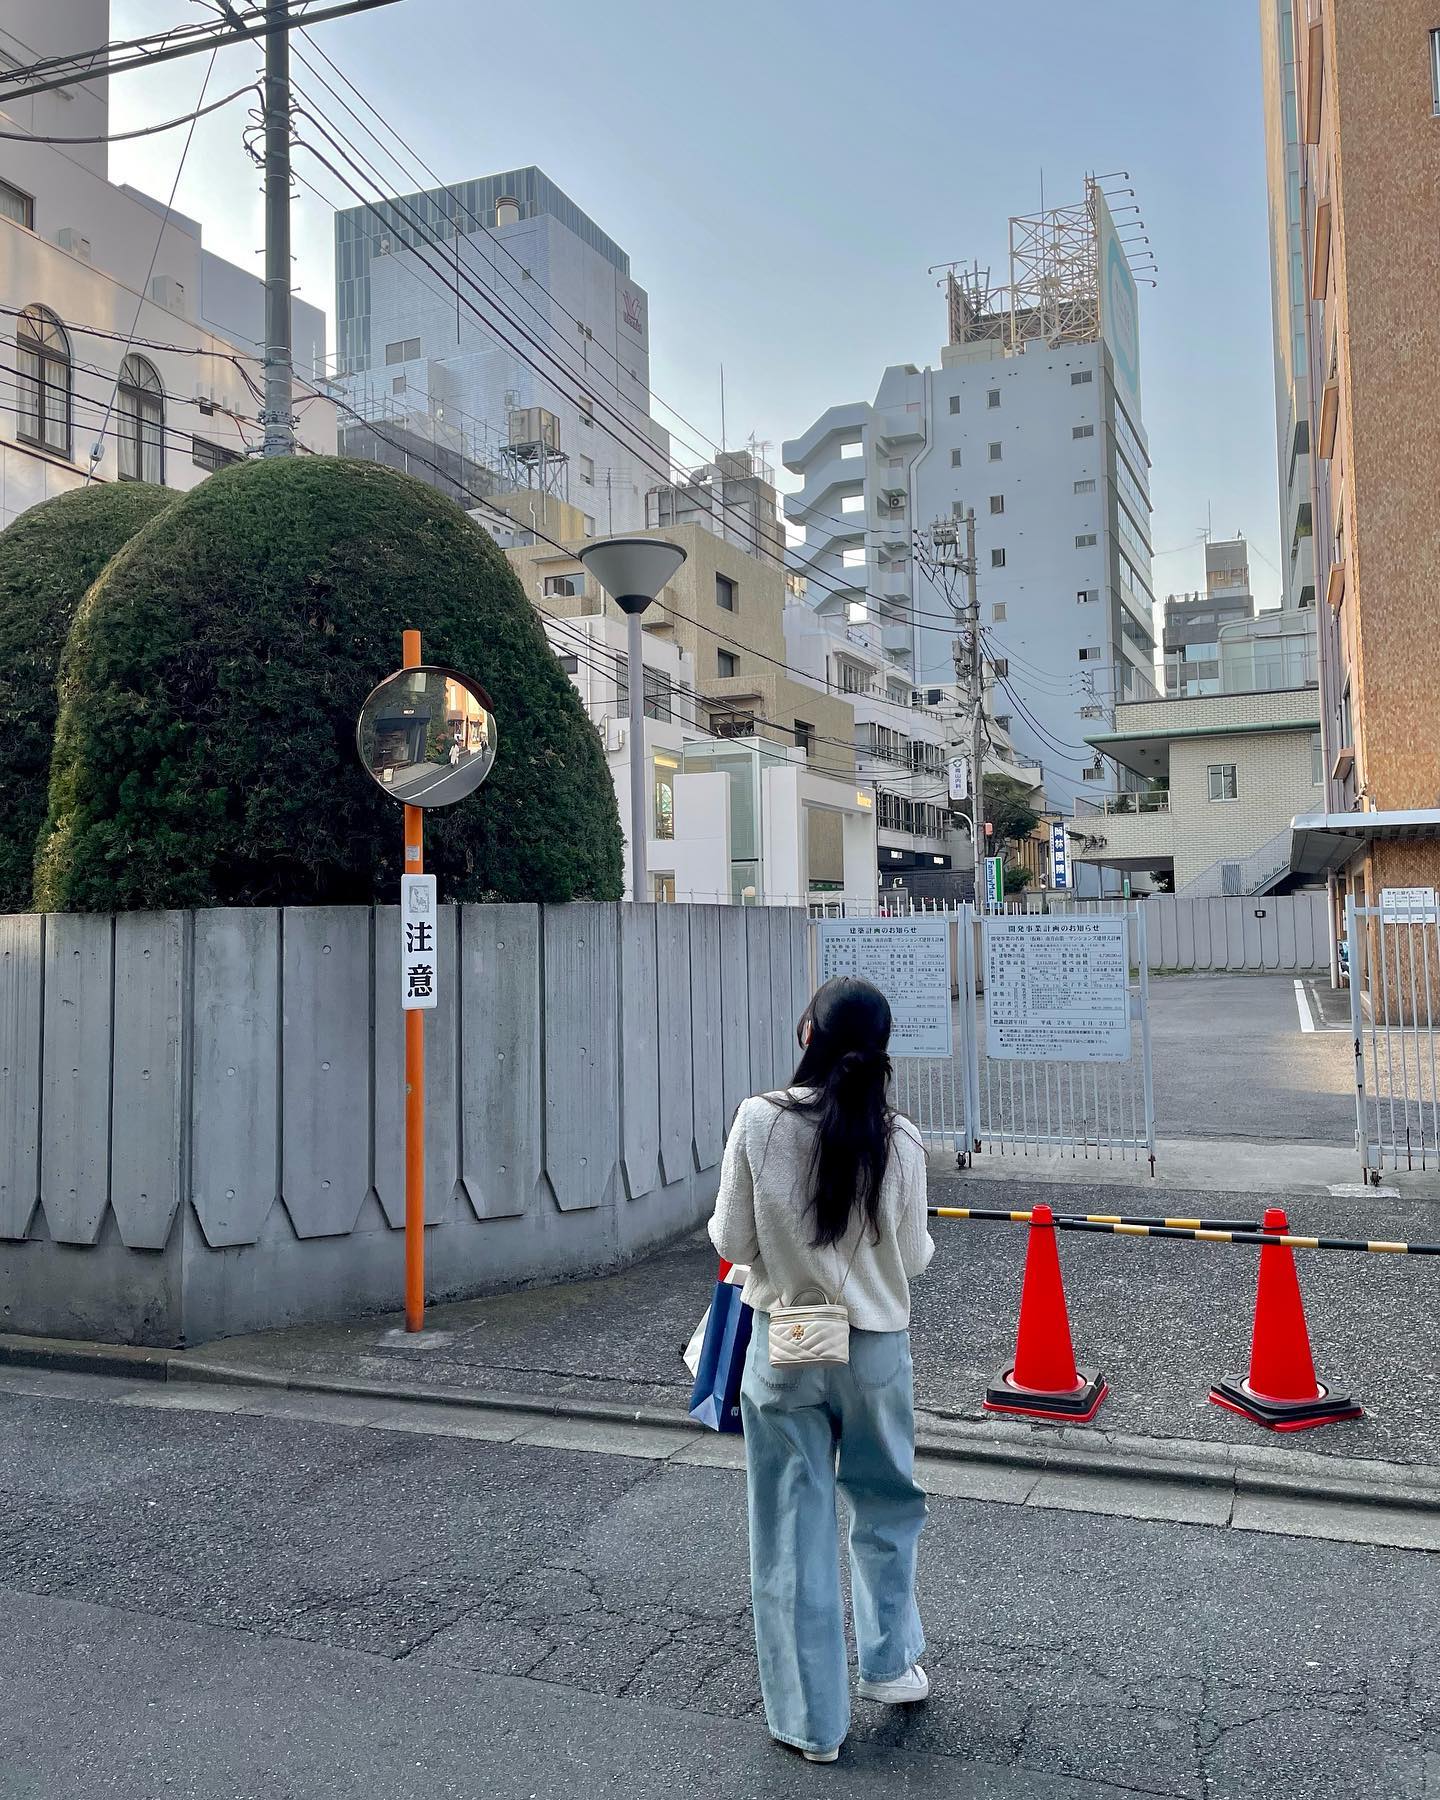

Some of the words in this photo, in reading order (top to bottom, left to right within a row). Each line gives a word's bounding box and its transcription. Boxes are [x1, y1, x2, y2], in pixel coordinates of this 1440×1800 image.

[987, 860, 996, 900] FamilyMart
[849, 926, 918, 934] 建築計画のお知らせ
[1008, 924, 1100, 933] 開発事業計画のお知らせ
[405, 921, 434, 998] 注意
